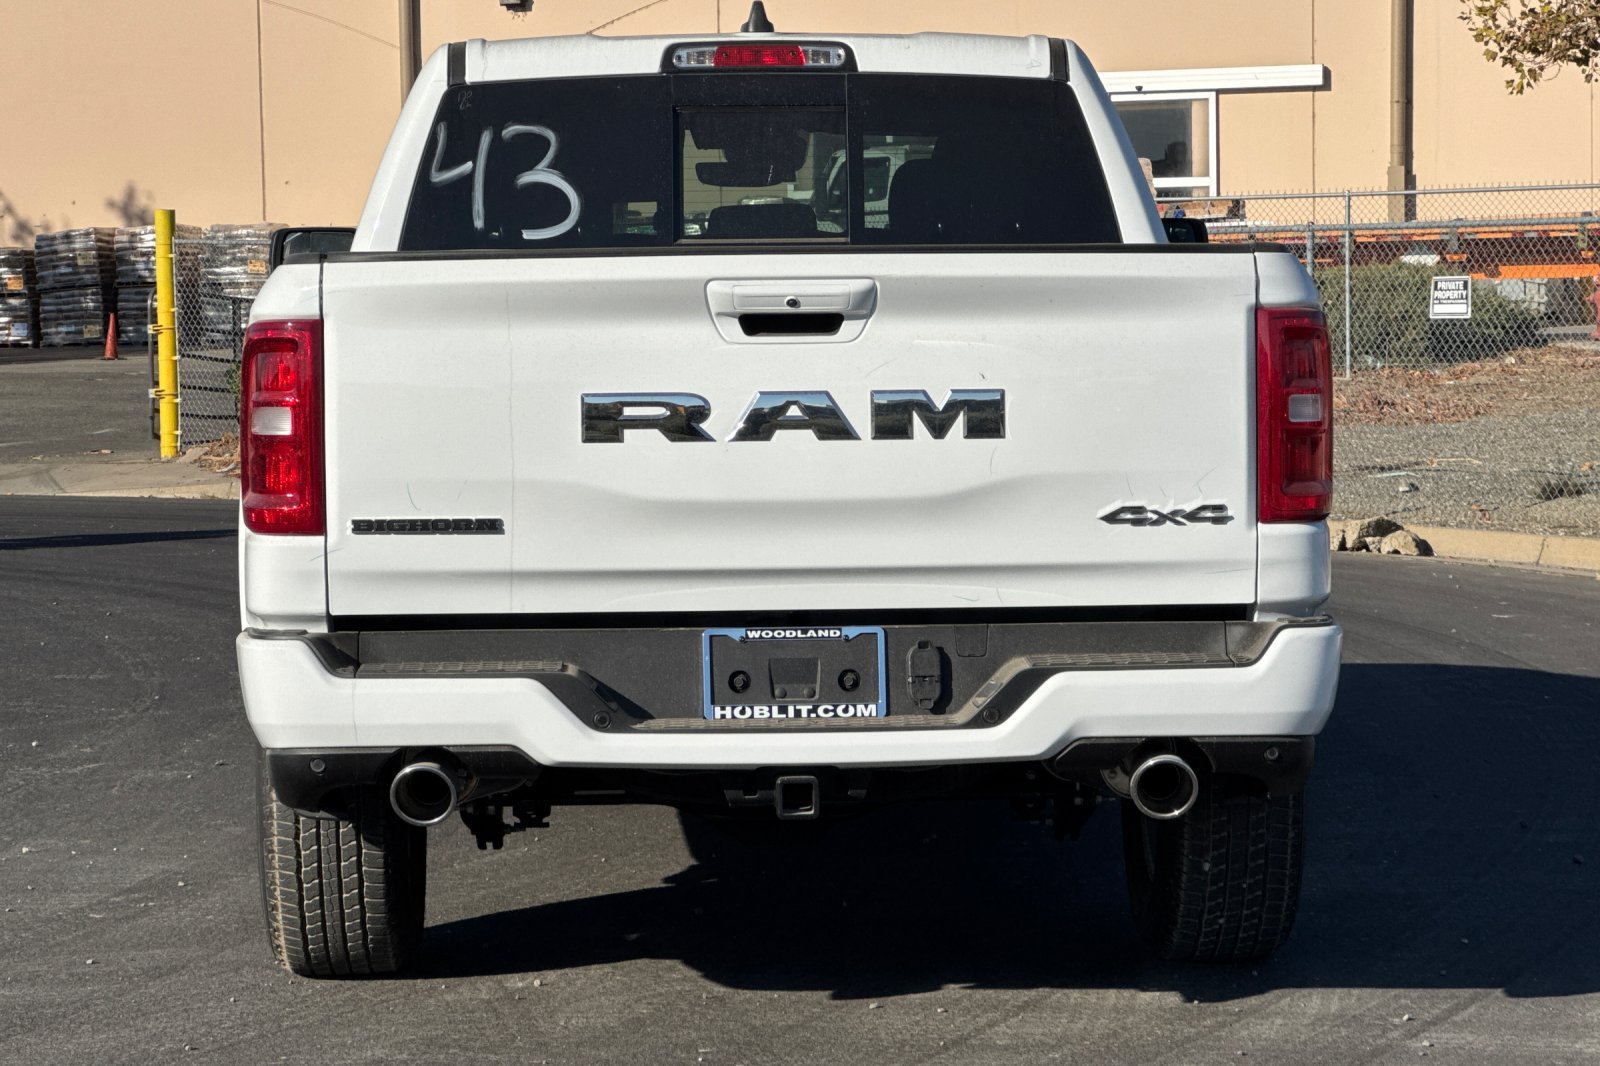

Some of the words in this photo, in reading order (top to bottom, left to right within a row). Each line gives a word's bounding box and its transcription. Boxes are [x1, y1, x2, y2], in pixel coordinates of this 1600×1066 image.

[430, 121, 581, 240] 43
[1437, 281, 1464, 290] PRIVATE
[1434, 290, 1467, 299] PROPERTY
[581, 388, 1006, 443] RAM
[351, 518, 505, 535] BIGHORN
[746, 629, 841, 639] WOODLAND
[714, 704, 877, 719] HOBLIT.COM
